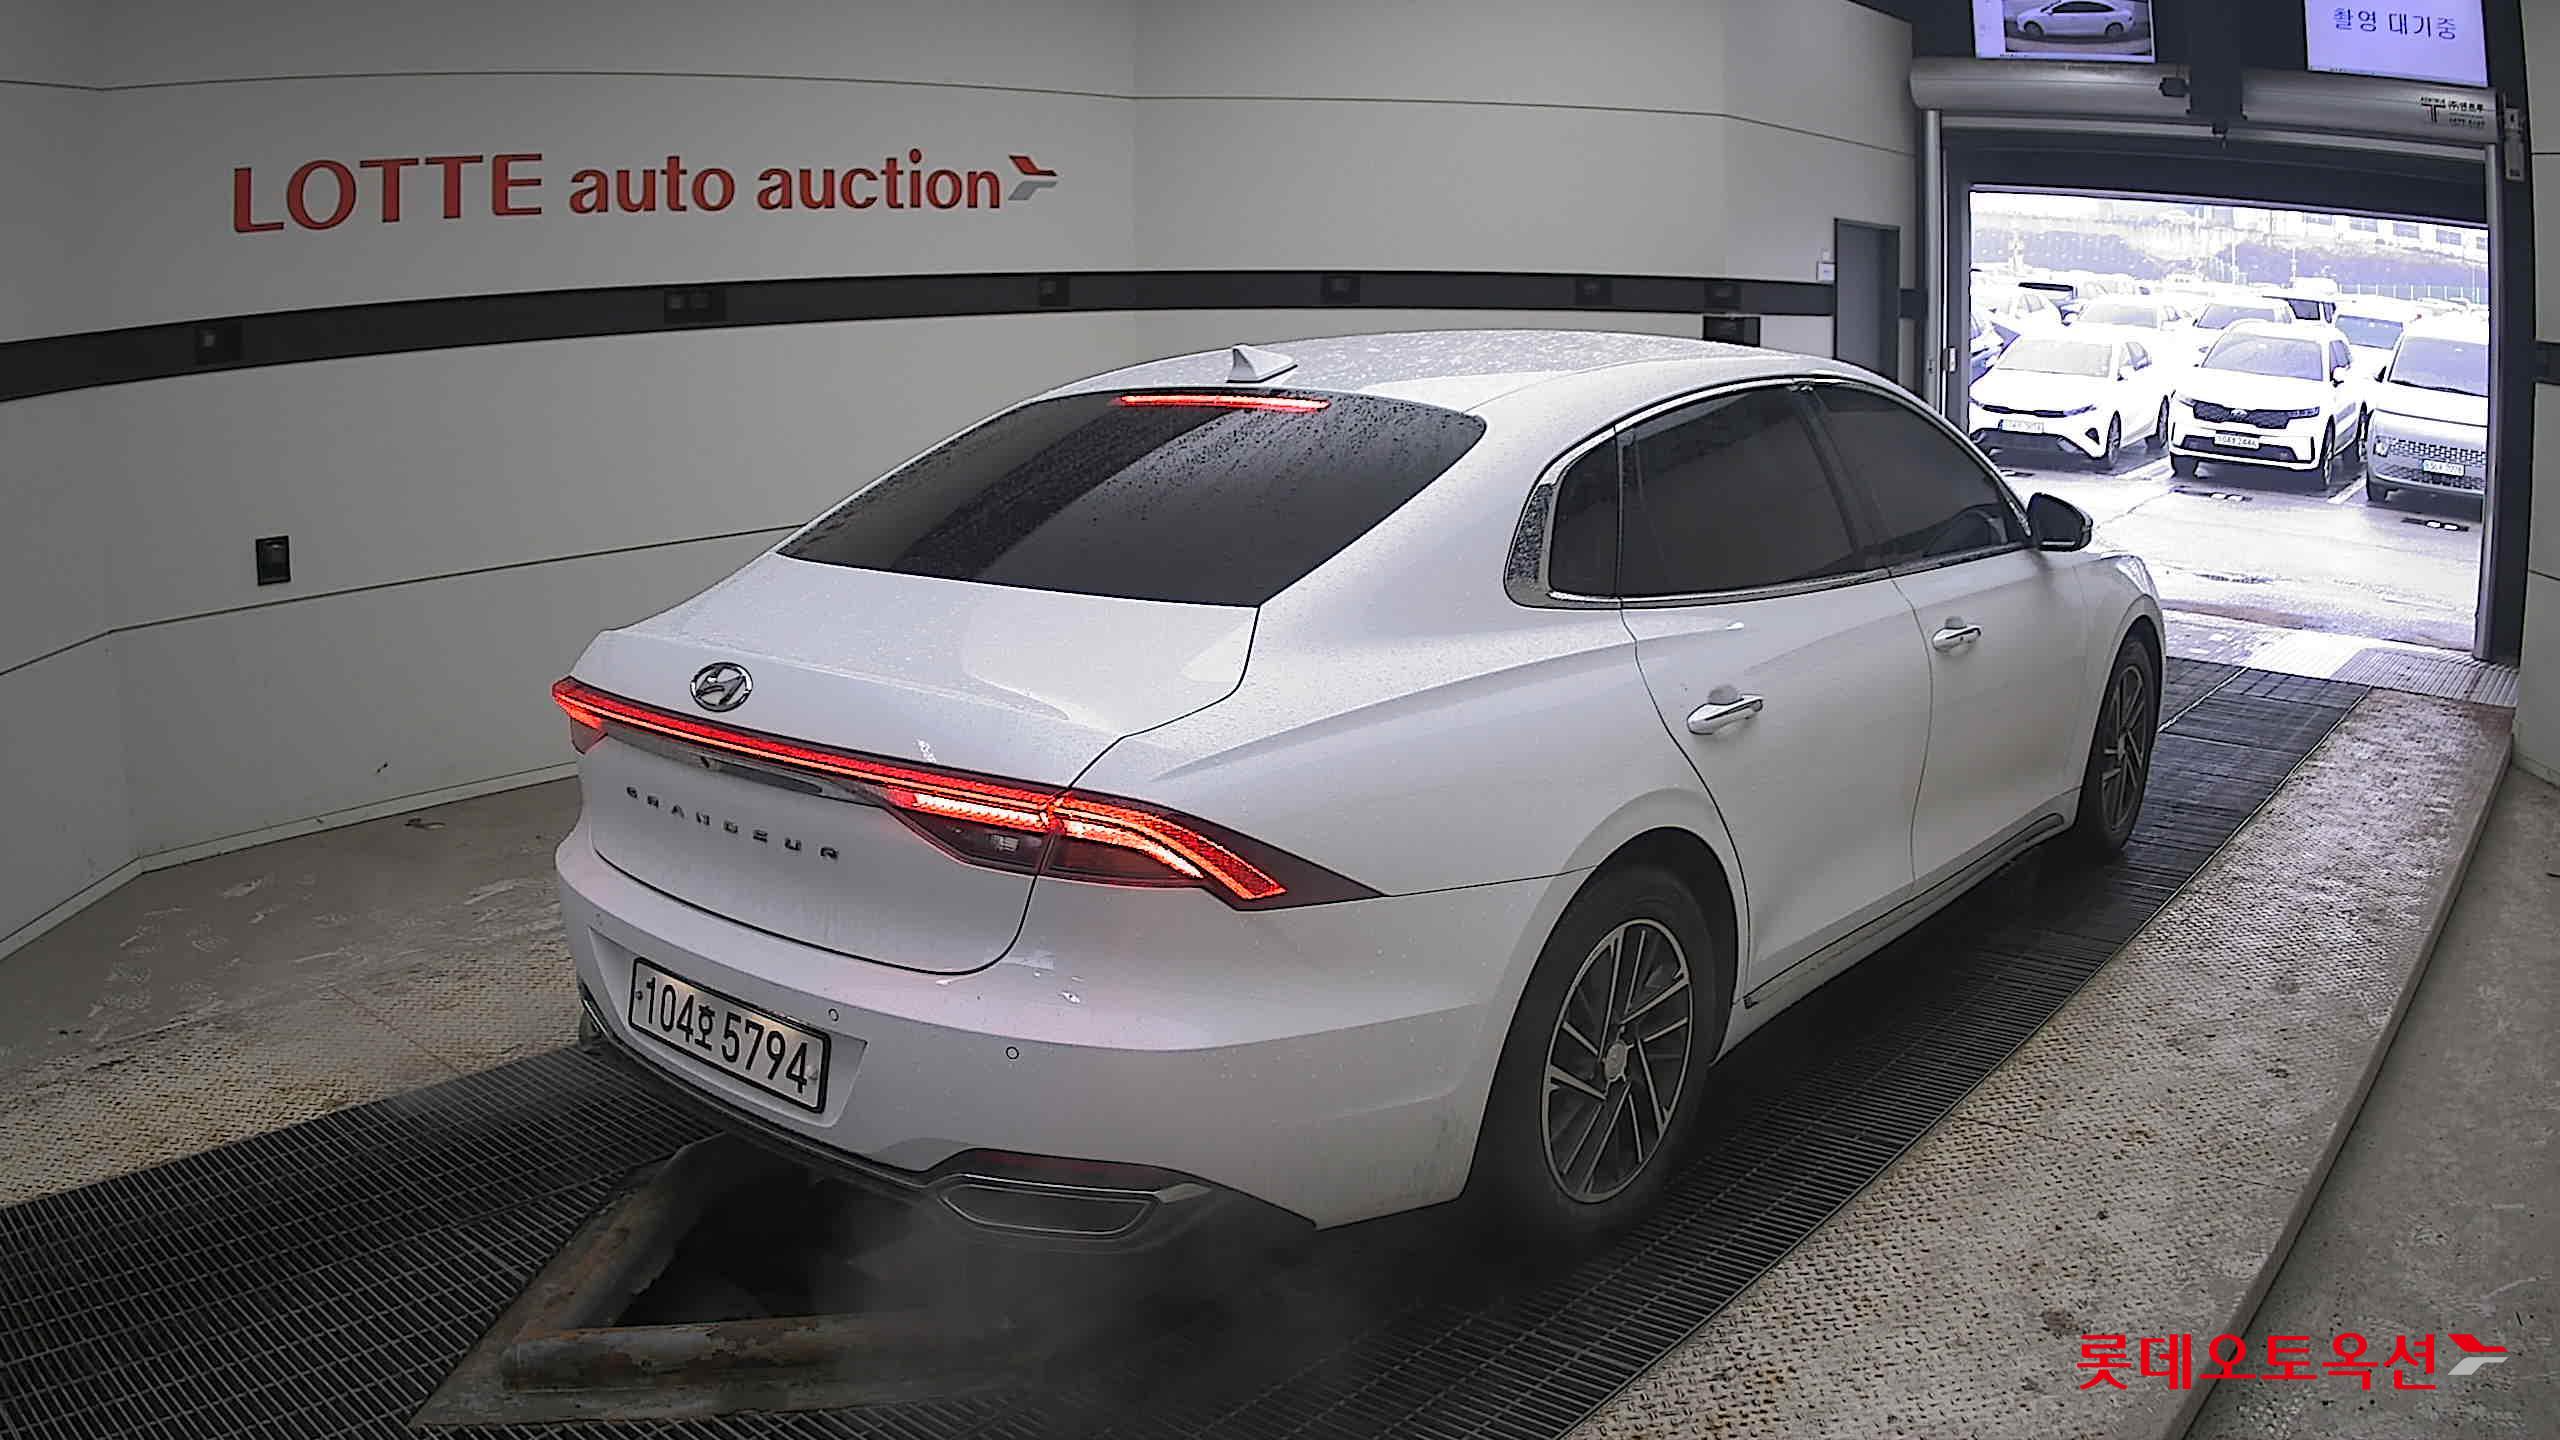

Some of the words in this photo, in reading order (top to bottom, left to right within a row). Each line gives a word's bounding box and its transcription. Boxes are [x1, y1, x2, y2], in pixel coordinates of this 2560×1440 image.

[2334, 8, 2377, 33] 촬영
[2388, 13, 2457, 41] 대기중
[234, 153, 543, 233] LOTTE
[569, 155, 736, 214] auto
[757, 148, 1001, 210] auction
[720, 1010, 809, 1094] 5794
